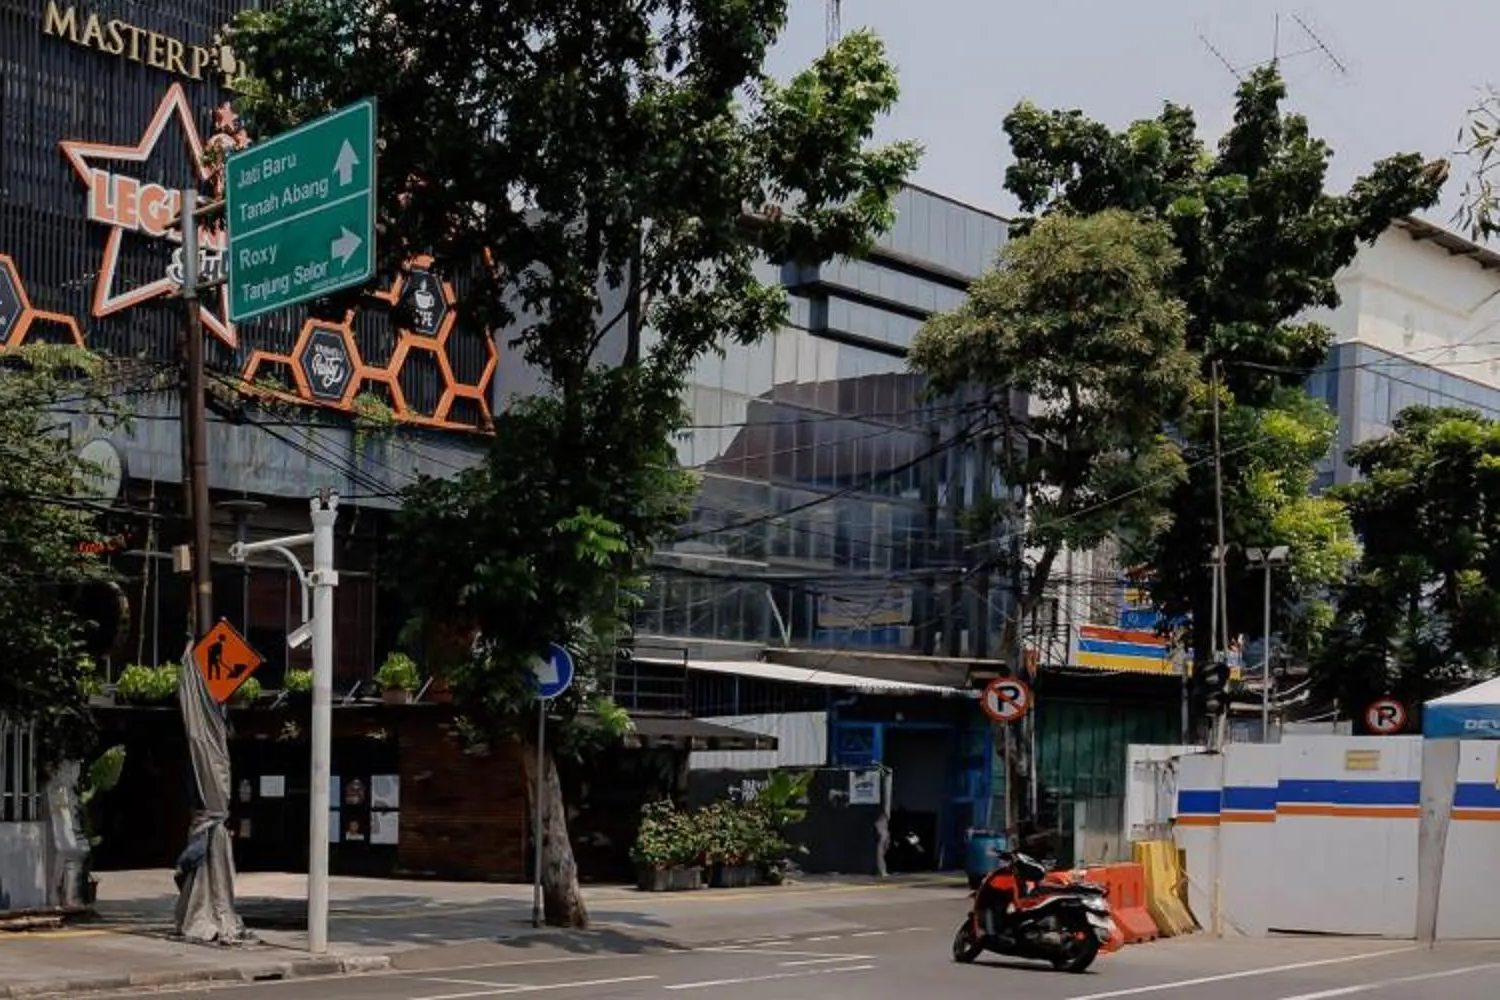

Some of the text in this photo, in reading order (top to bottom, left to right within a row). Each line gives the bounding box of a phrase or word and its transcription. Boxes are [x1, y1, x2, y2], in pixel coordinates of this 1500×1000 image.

[43, 0, 247, 90] MASTERP
[237, 153, 298, 189] Jati Baru
[239, 177, 330, 223] Tanah Abang
[239, 243, 278, 271] Roxy
[241, 274, 290, 303] Tanjung
[293, 260, 329, 285] Selor
